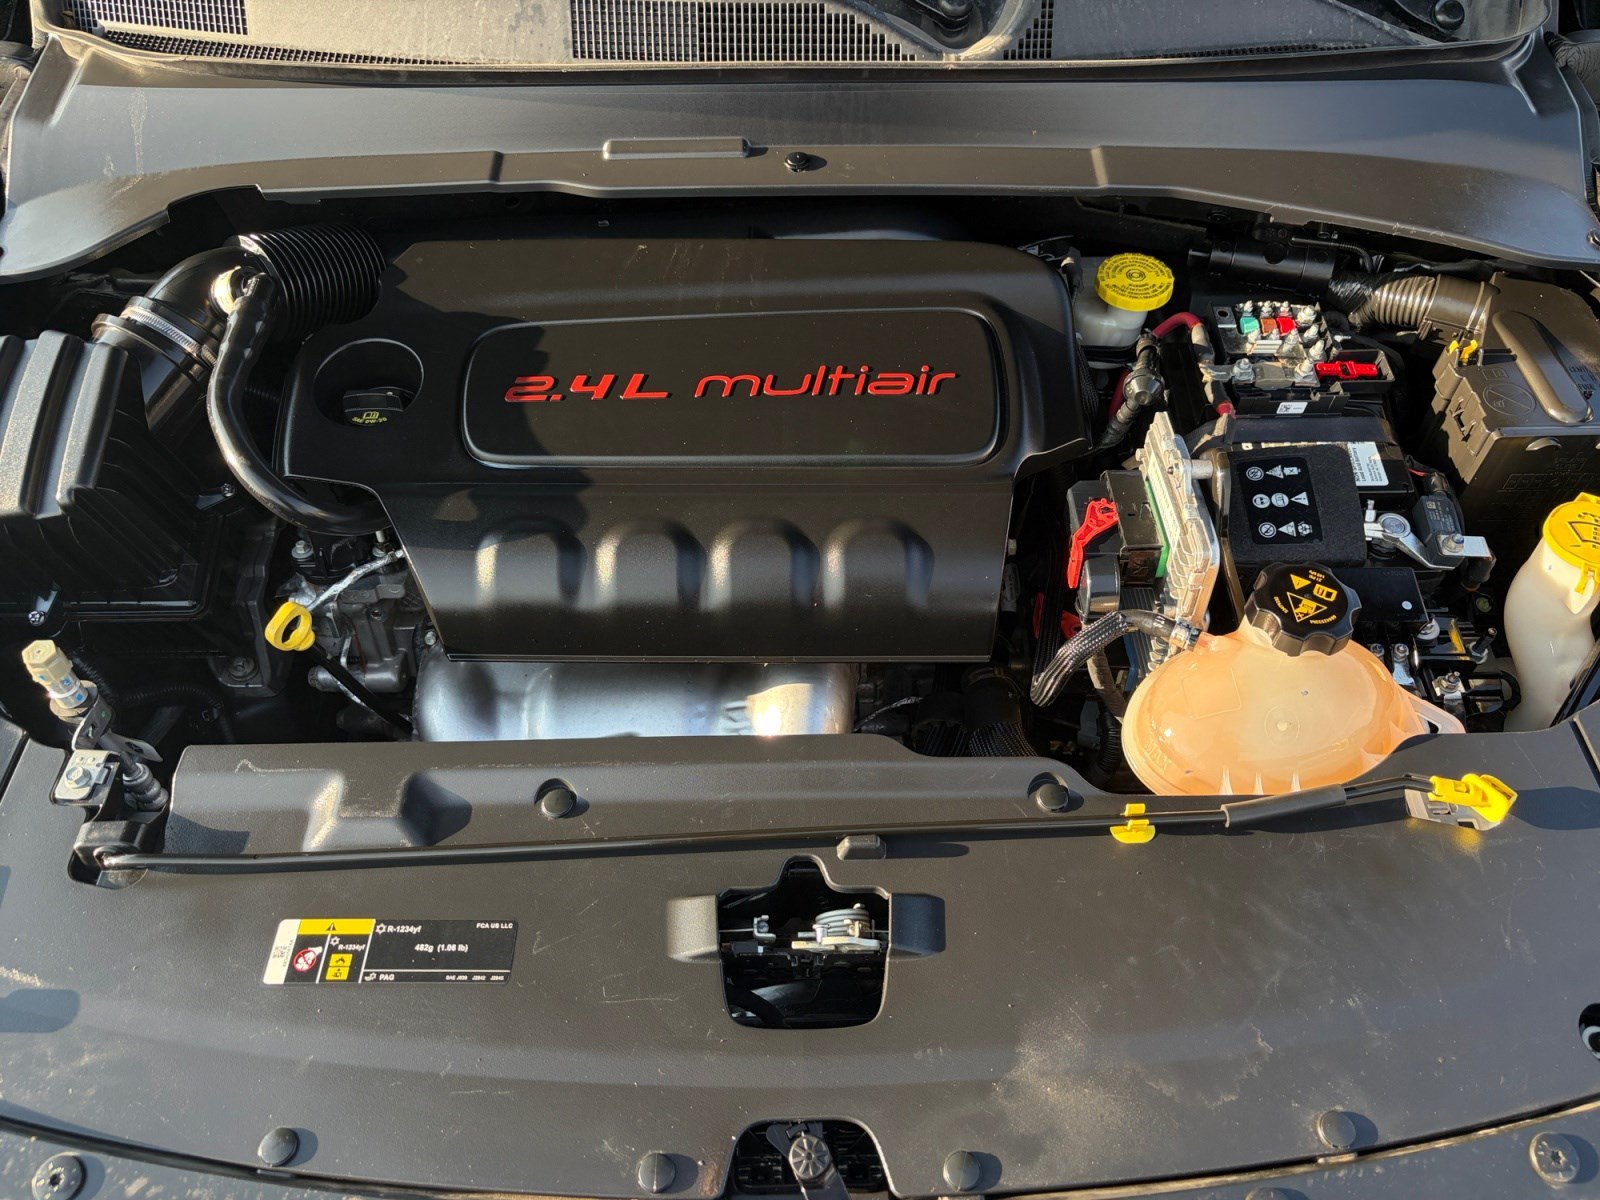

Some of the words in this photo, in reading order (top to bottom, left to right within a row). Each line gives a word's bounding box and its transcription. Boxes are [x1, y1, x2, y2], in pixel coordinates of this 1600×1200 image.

[693, 365, 956, 397] multiair
[387, 925, 422, 935] R-1234yf
[437, 943, 457, 953] (1.06
[457, 943, 469, 953] lb)
[379, 973, 395, 981] PAG
